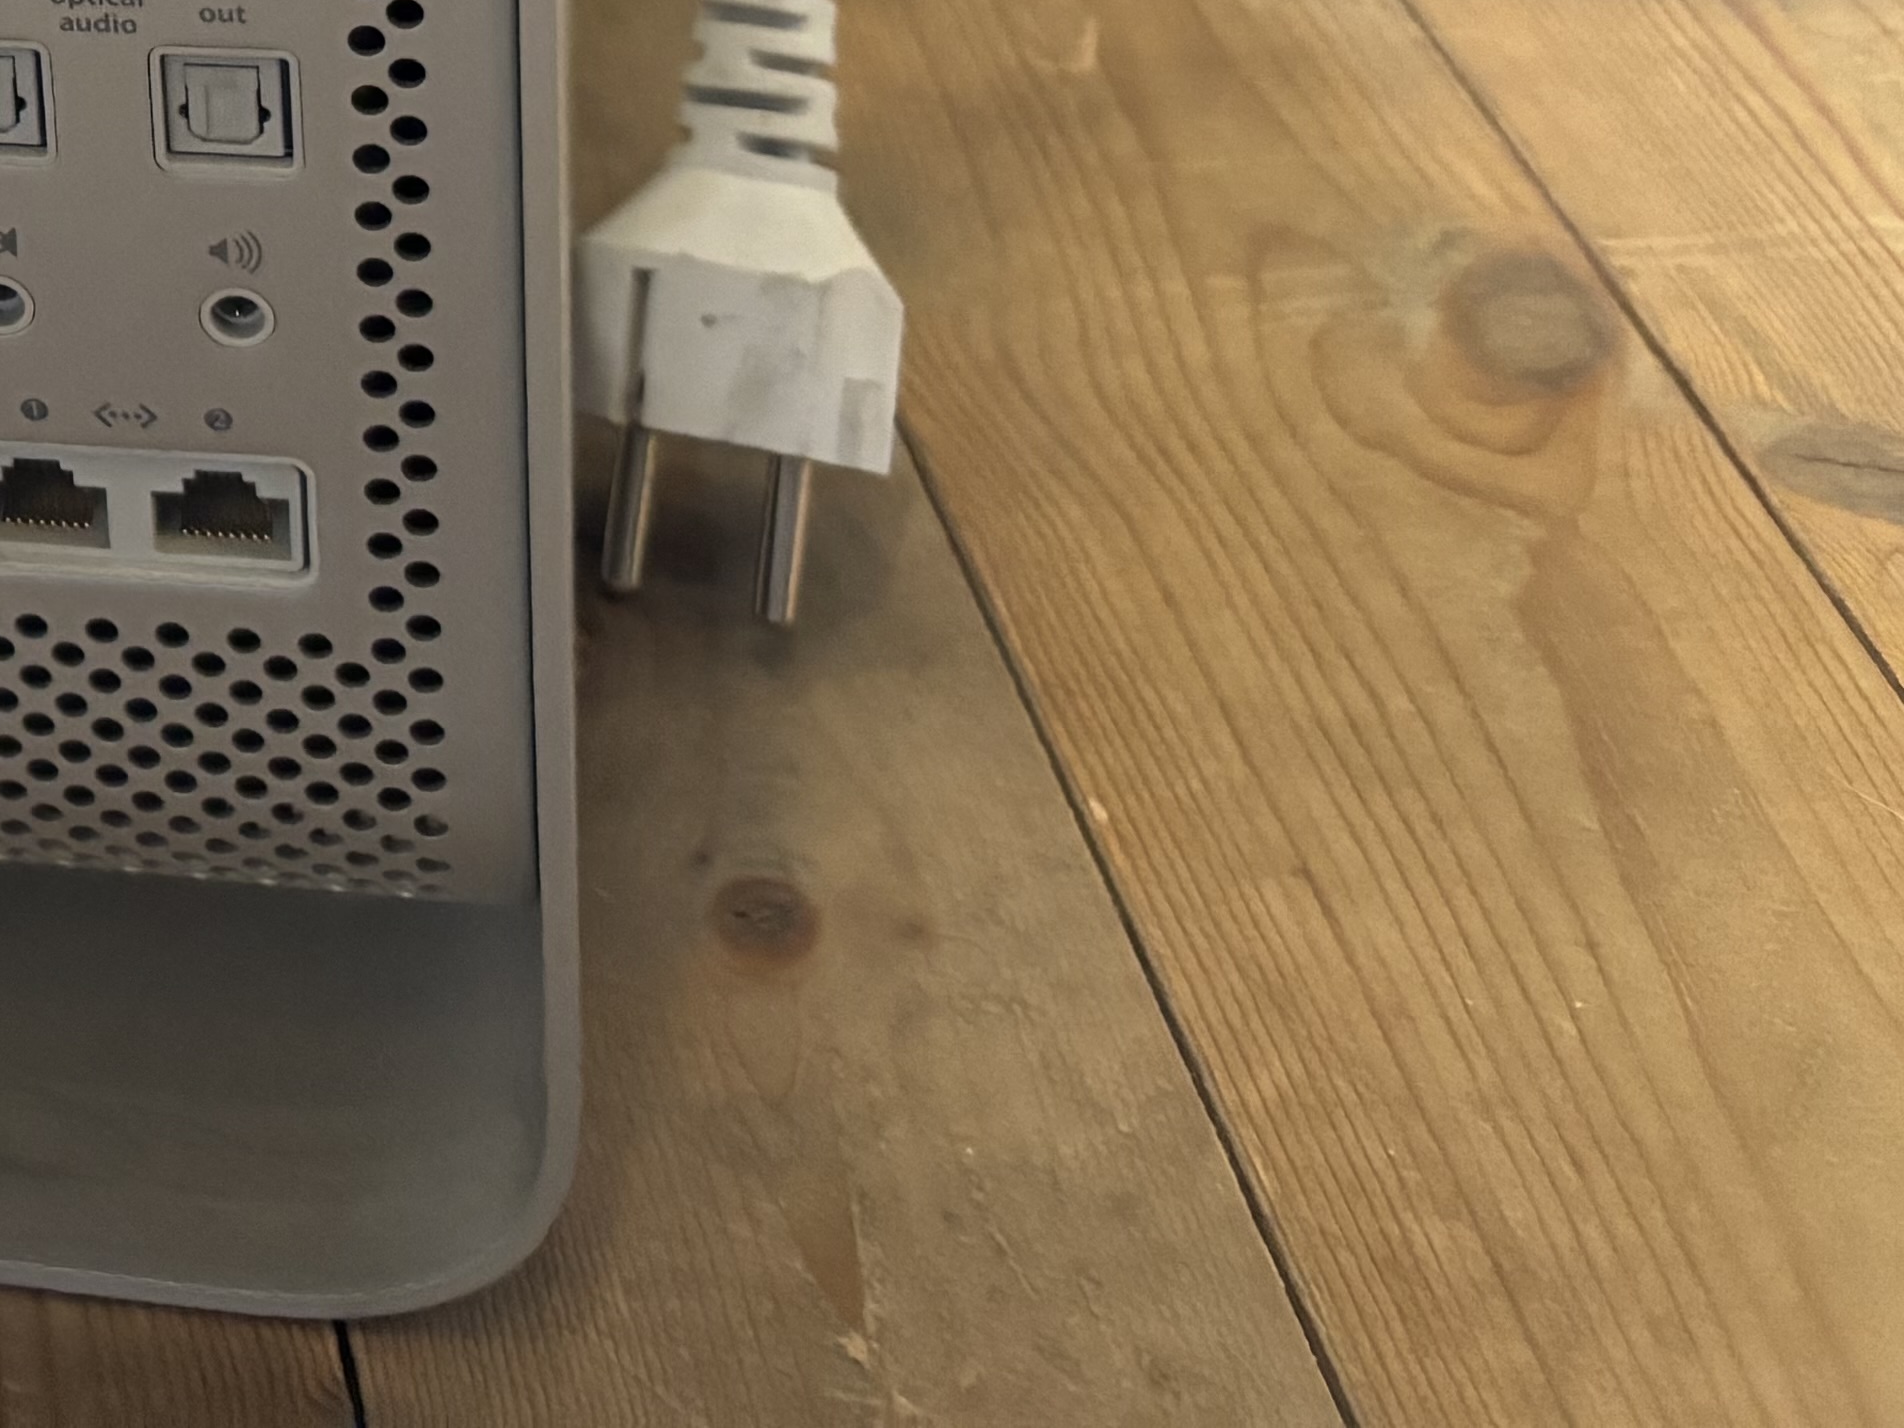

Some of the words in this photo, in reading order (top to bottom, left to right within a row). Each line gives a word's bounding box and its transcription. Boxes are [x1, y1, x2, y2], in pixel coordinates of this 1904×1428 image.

[59, 12, 138, 35] audio
[199, 5, 247, 25] out
[206, 409, 232, 431] 2
